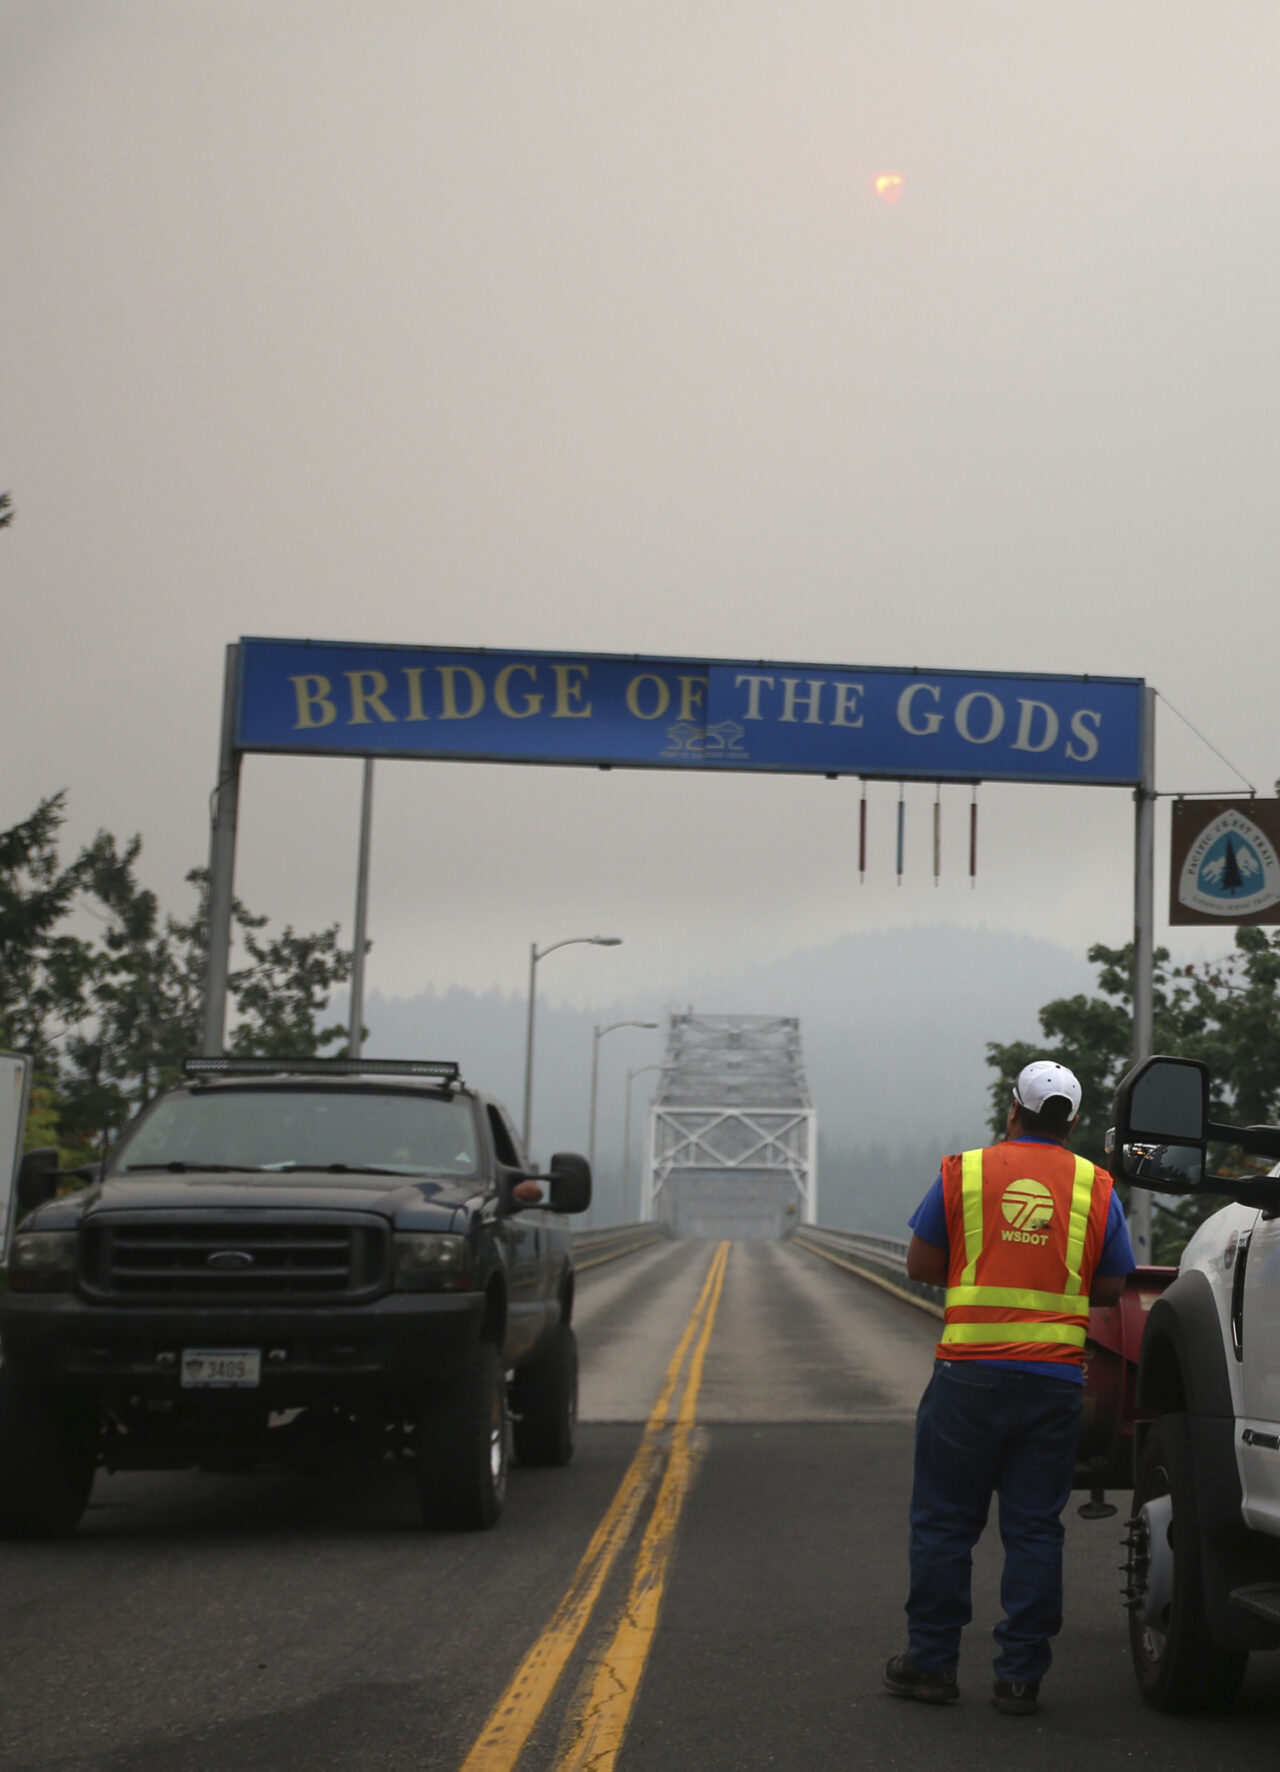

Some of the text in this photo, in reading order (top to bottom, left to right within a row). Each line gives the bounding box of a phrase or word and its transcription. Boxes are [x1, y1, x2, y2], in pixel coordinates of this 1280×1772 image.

[288, 663, 1102, 762] BRIDGE OF THE GODS
[1187, 820, 1275, 875] PACIFIC CREST TRAIL
[1000, 1230, 1049, 1246] WSDOT
